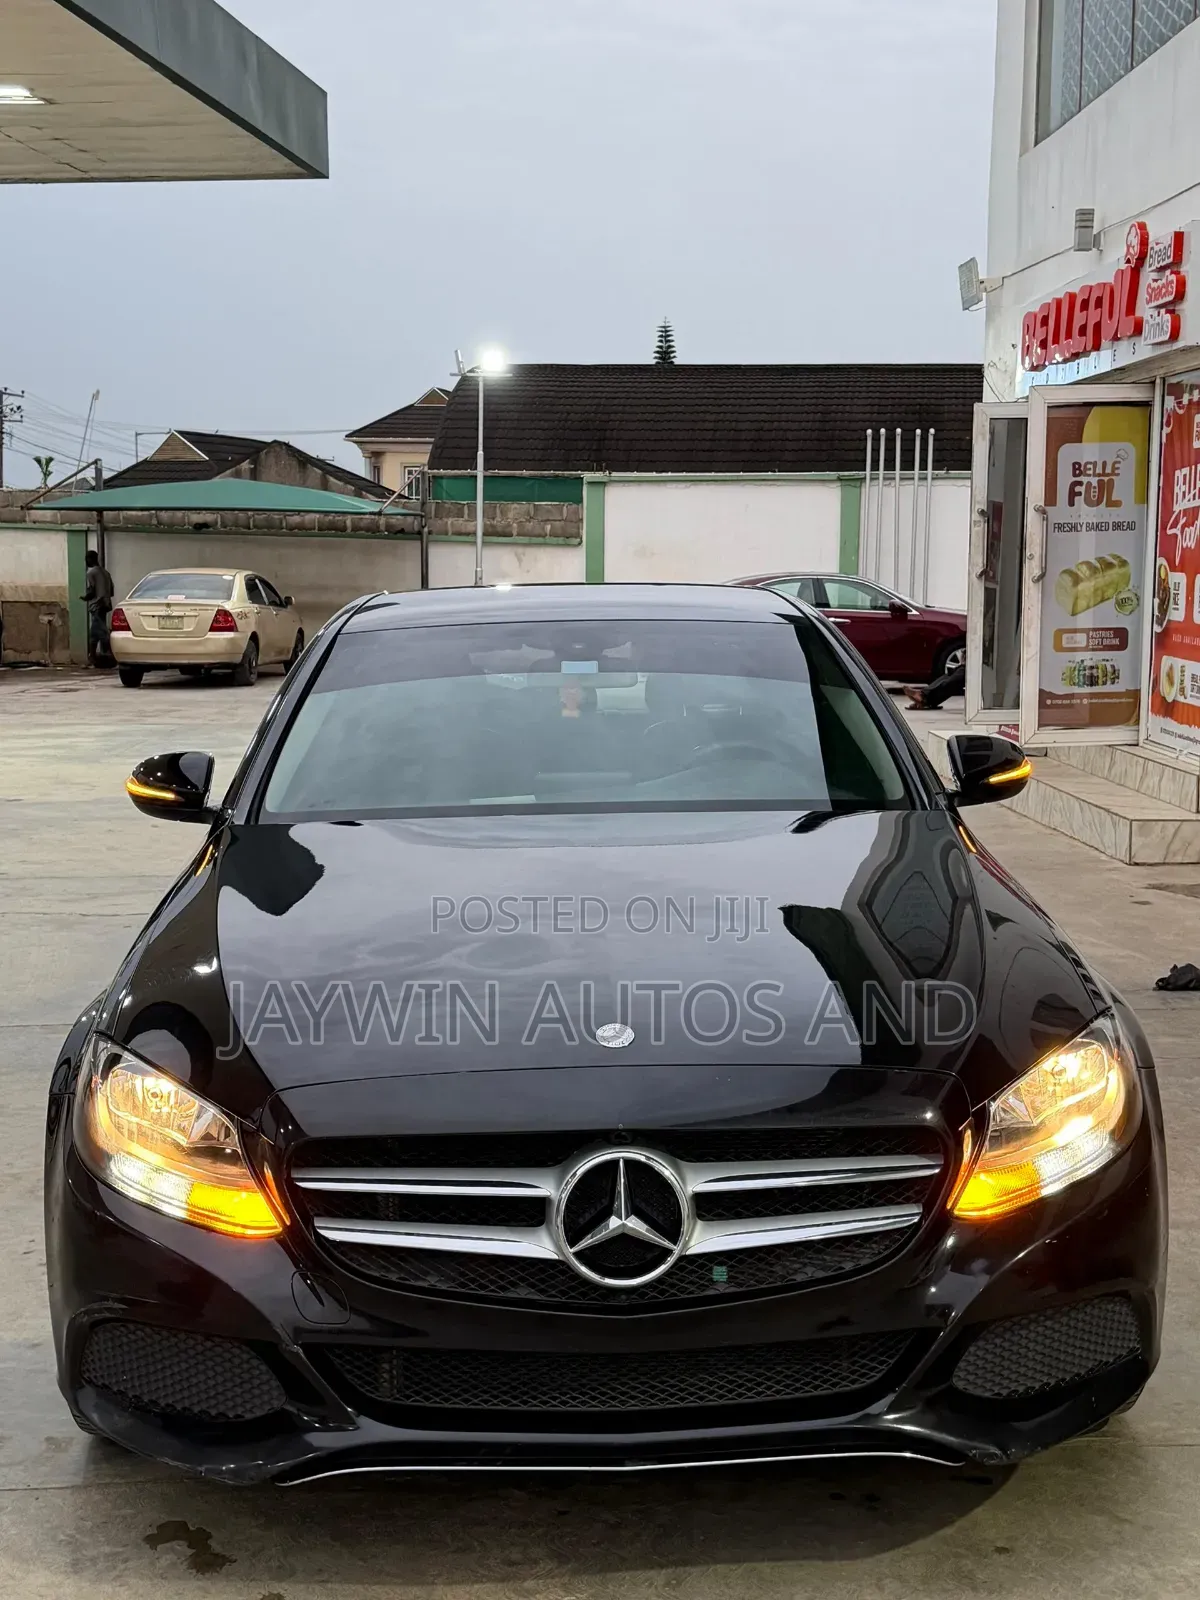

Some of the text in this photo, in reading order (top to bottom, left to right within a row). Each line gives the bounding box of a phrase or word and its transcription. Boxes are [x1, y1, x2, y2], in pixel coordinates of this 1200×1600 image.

[1148, 236, 1172, 269] Bread
[1146, 274, 1174, 305] Snacks
[1022, 266, 1140, 371] BELLEFUL
[1143, 313, 1169, 341] Drinks
[1072, 460, 1122, 477] BELLE
[1068, 478, 1123, 508] FUL
[1053, 520, 1136, 533] FRESHLY BAKED BREAD
[1089, 630, 1114, 638] PASTRIES
[1089, 638, 1102, 646] SOFT
[1102, 637, 1120, 645] DRINK
